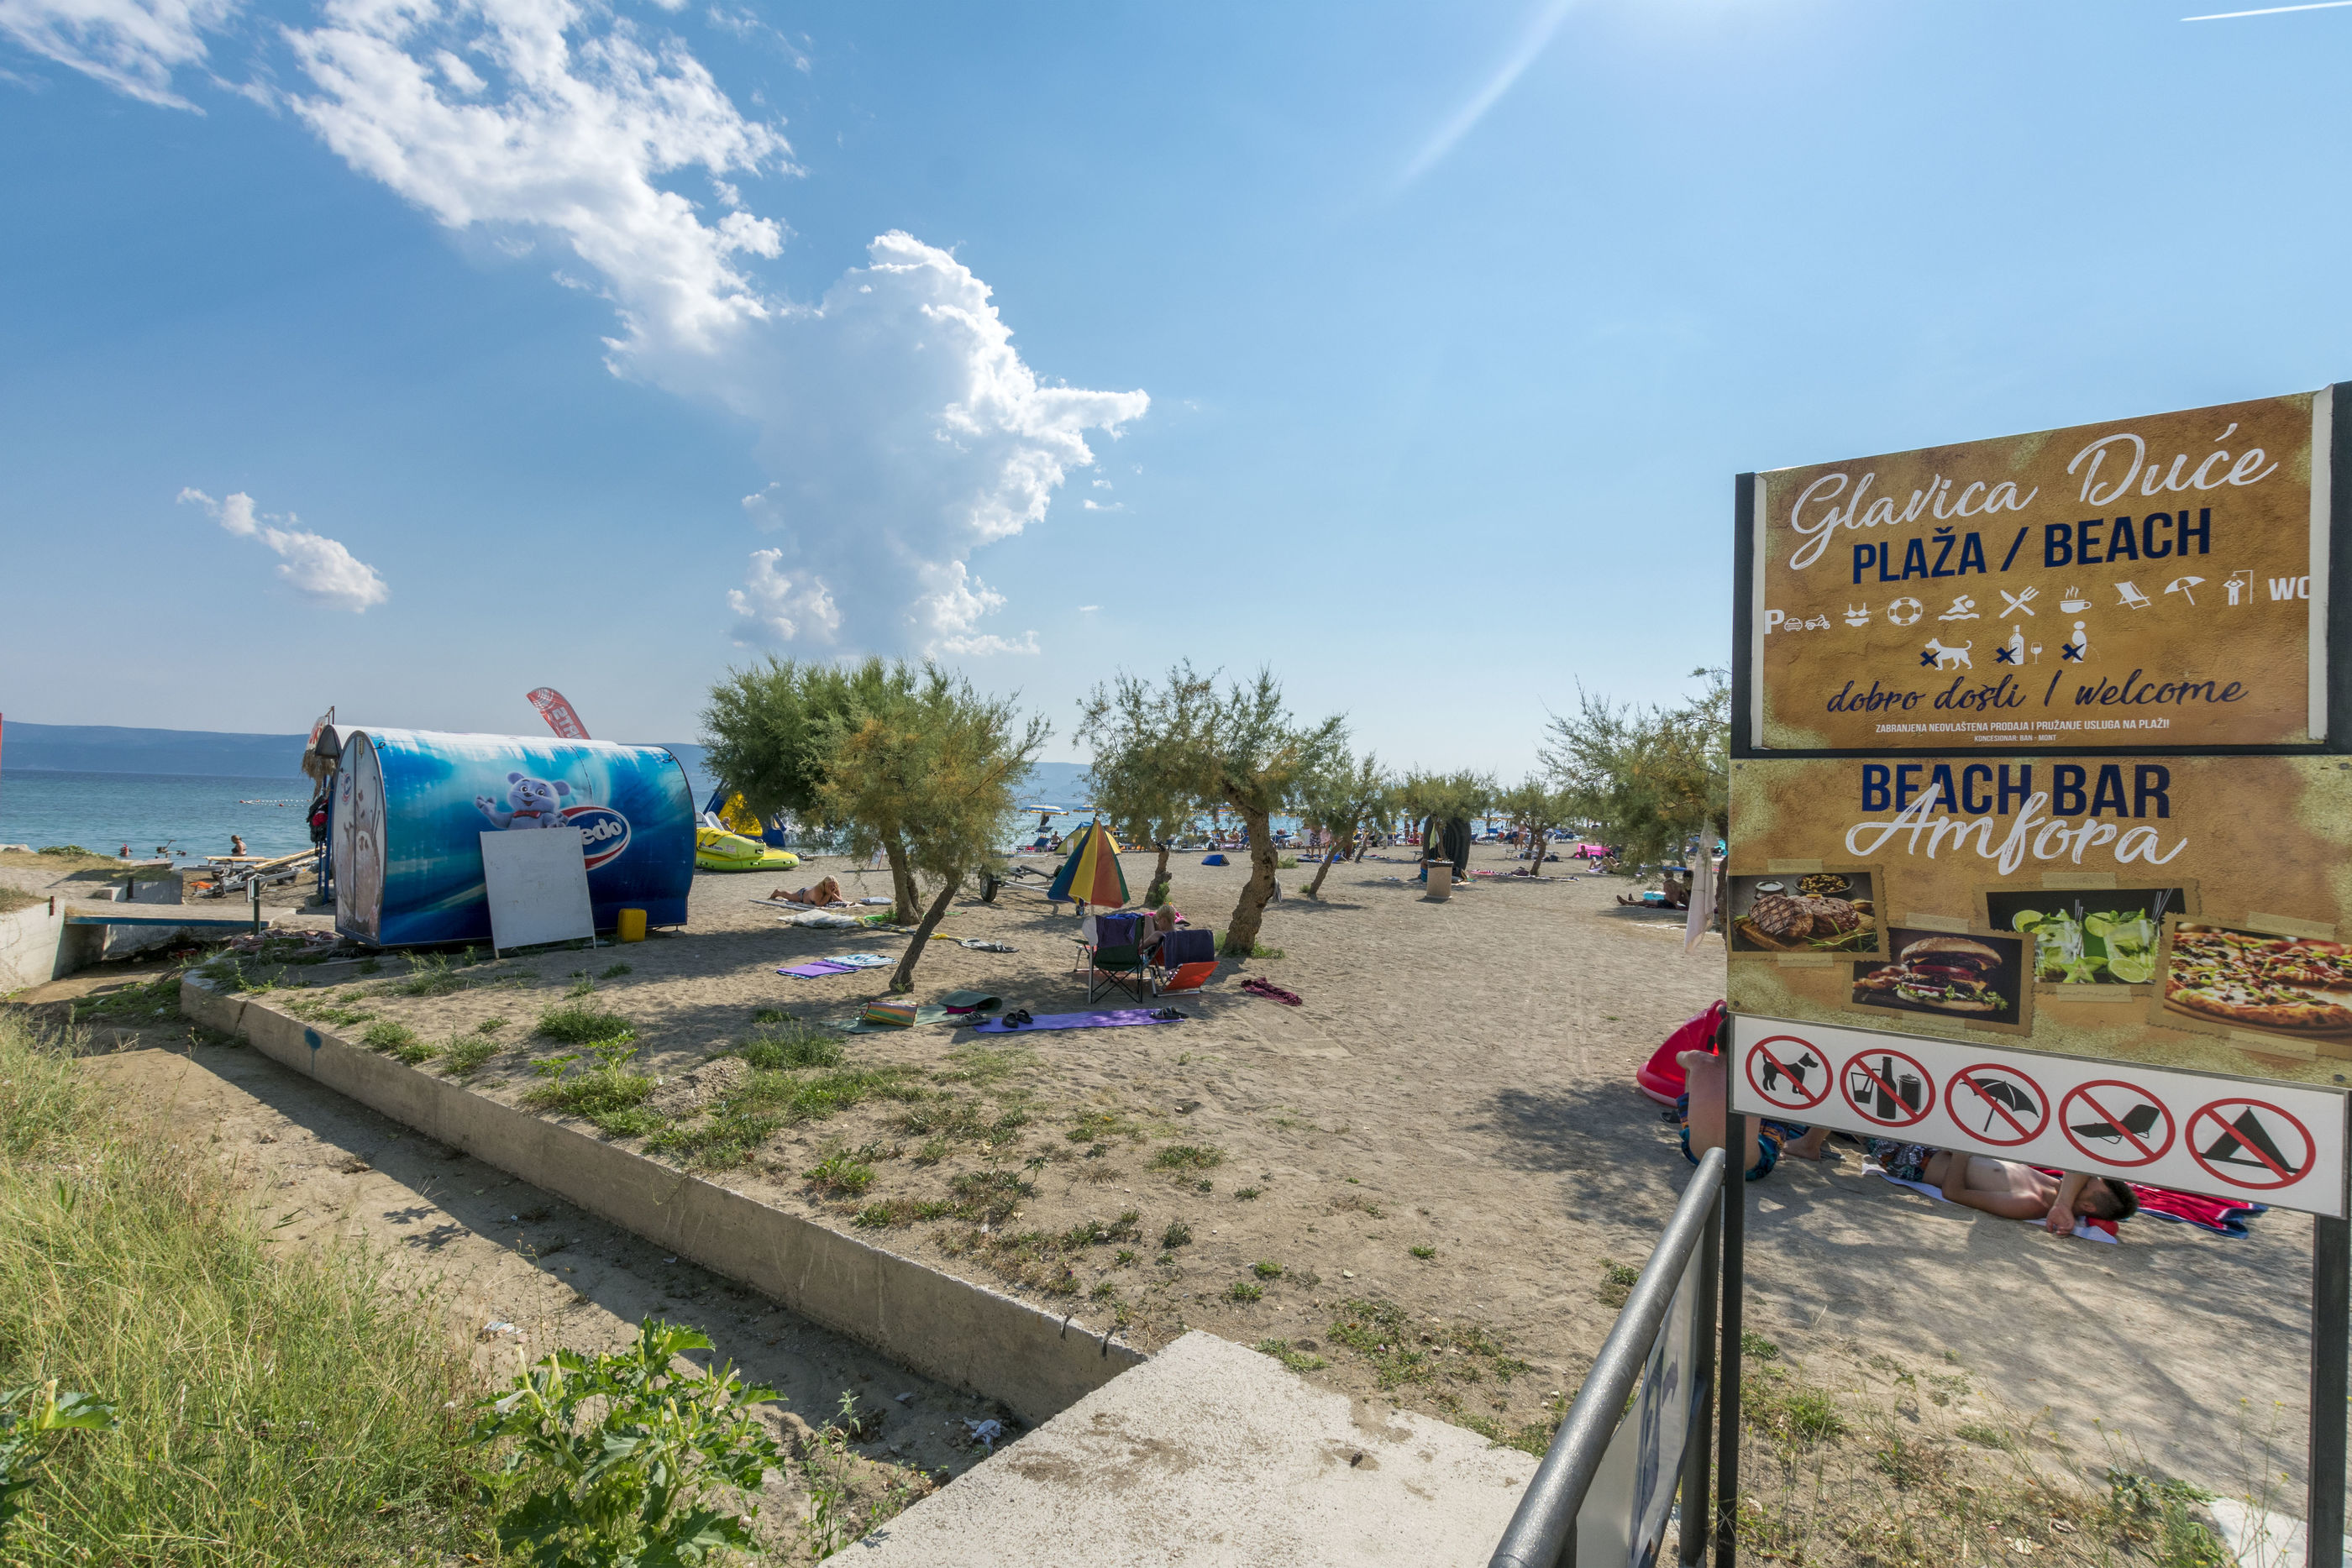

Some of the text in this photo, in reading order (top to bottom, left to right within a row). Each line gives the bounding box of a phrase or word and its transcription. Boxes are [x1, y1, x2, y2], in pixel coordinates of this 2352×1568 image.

[1789, 422, 2279, 570] Glavica Duće
[1852, 507, 2211, 585] PLAŽA / BEACH
[1826, 680, 1926, 712] dobro
[1933, 674, 2026, 712] došli
[2075, 669, 2249, 706] welcome
[1876, 722, 1927, 733] ZABRANJENA
[1929, 721, 1988, 732] NEOVLAŠTENA
[1990, 721, 2029, 732] PRODAJA
[2036, 719, 2082, 731] PRUŽANJE
[2084, 720, 2121, 730] USLUGA
[2123, 720, 2137, 729] NA
[1861, 763, 2171, 819] BEACH BAR
[1845, 783, 2188, 877] Amfora
